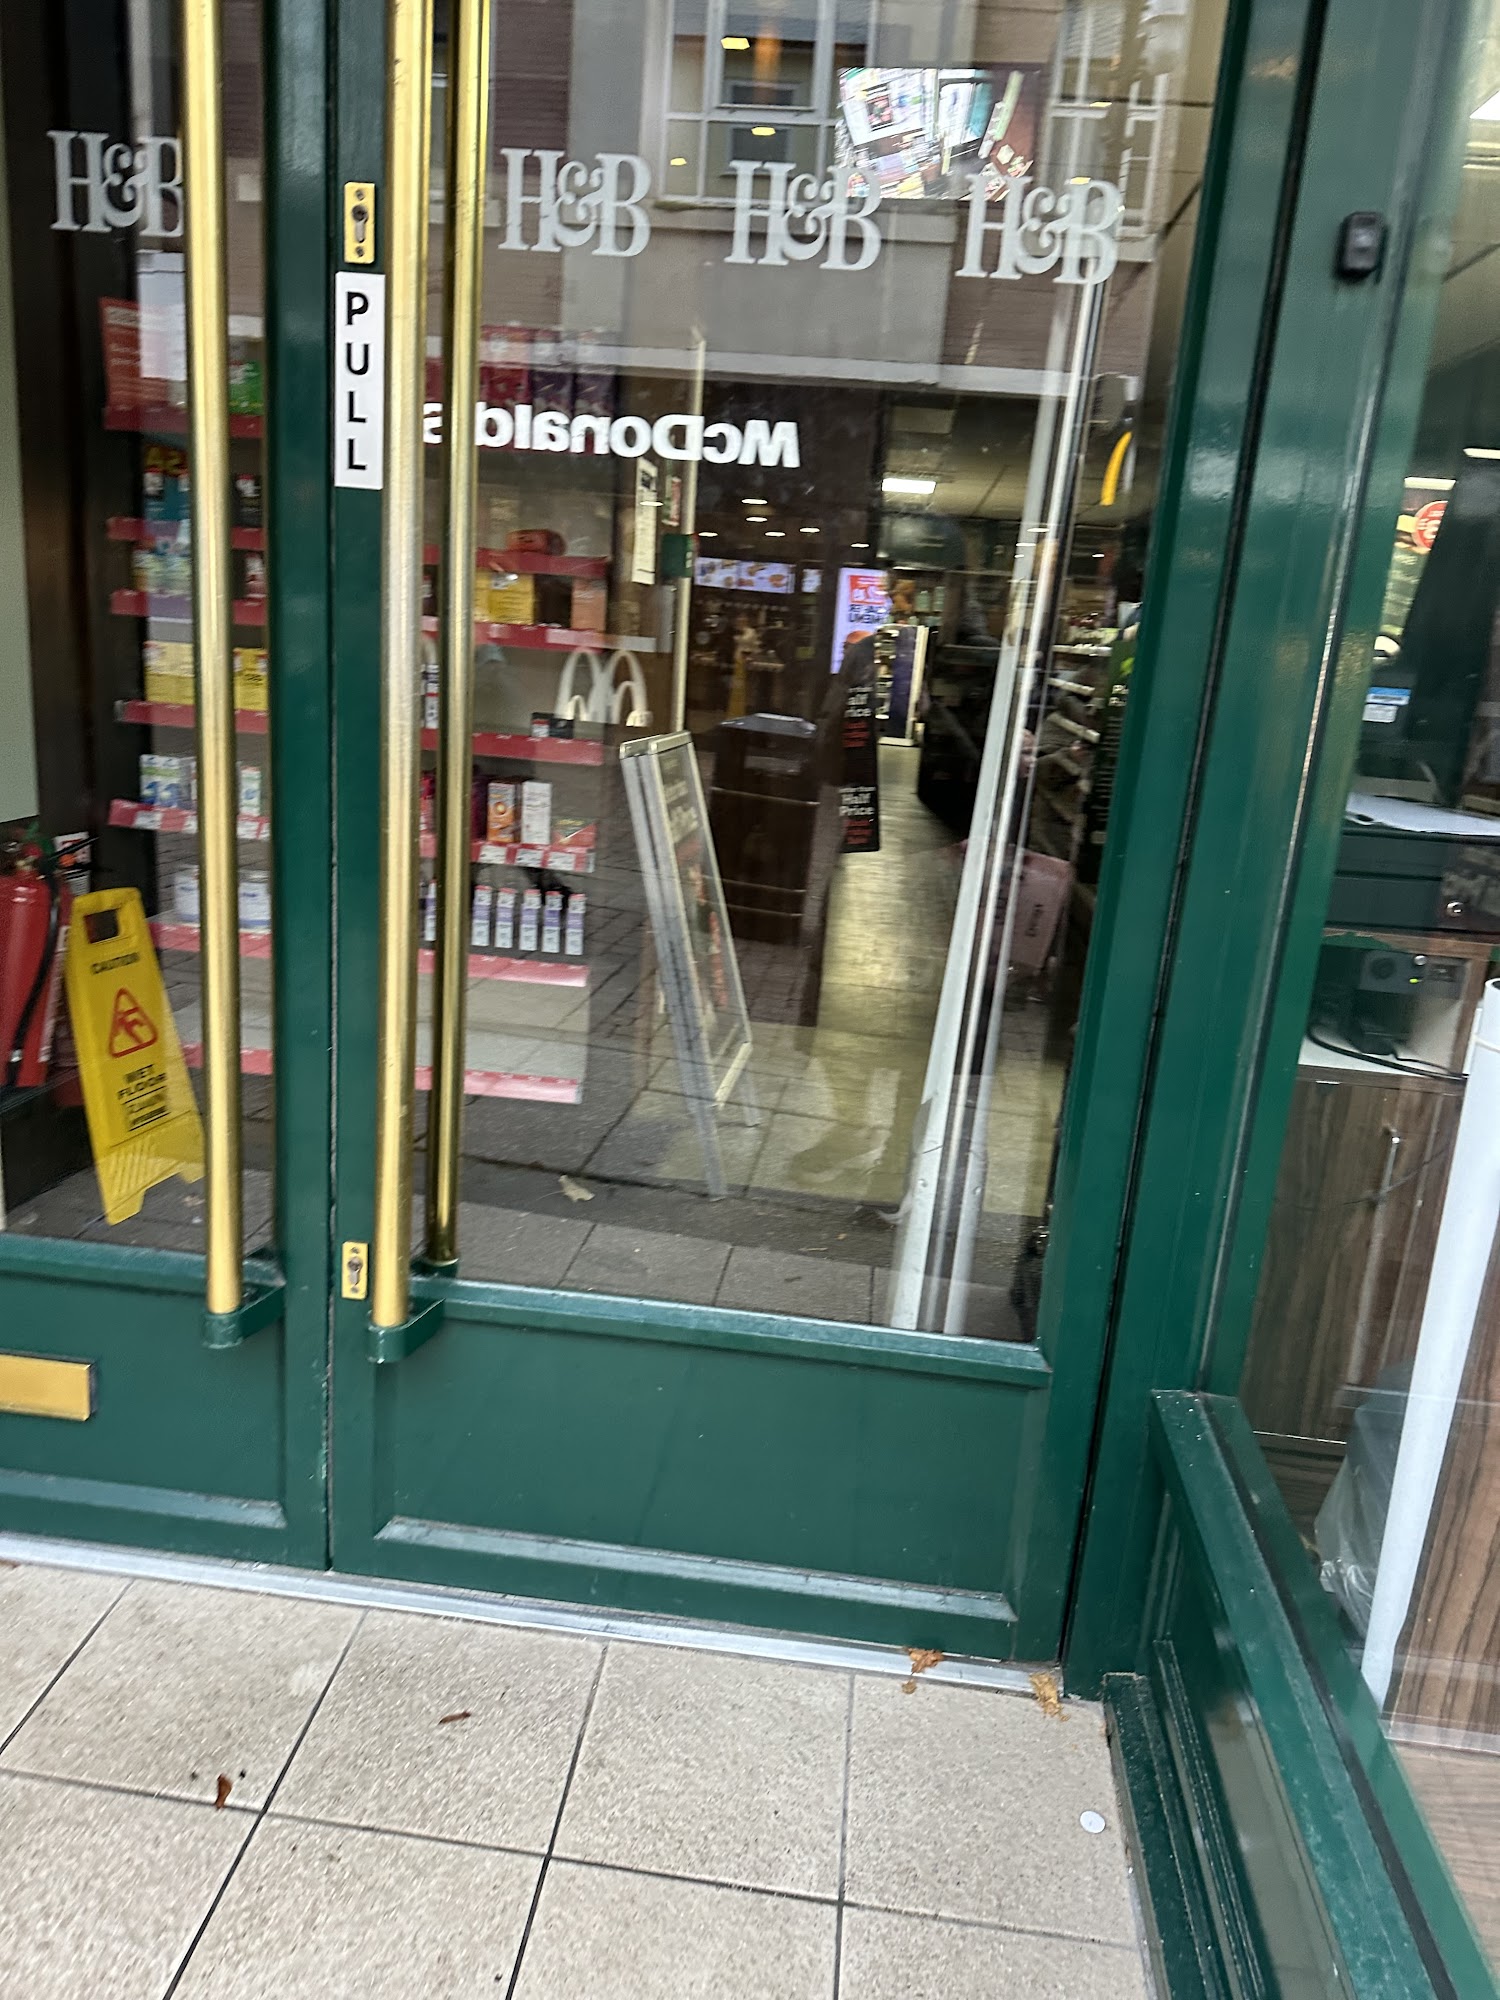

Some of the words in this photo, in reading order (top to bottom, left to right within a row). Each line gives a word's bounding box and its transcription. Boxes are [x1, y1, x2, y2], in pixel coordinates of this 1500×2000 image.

[47, 130, 183, 238] H&B
[498, 147, 652, 258] H&B
[723, 159, 881, 272] H&B
[955, 173, 1124, 286] H&B
[345, 291, 371, 471] PULL
[838, 804, 876, 817] Price
